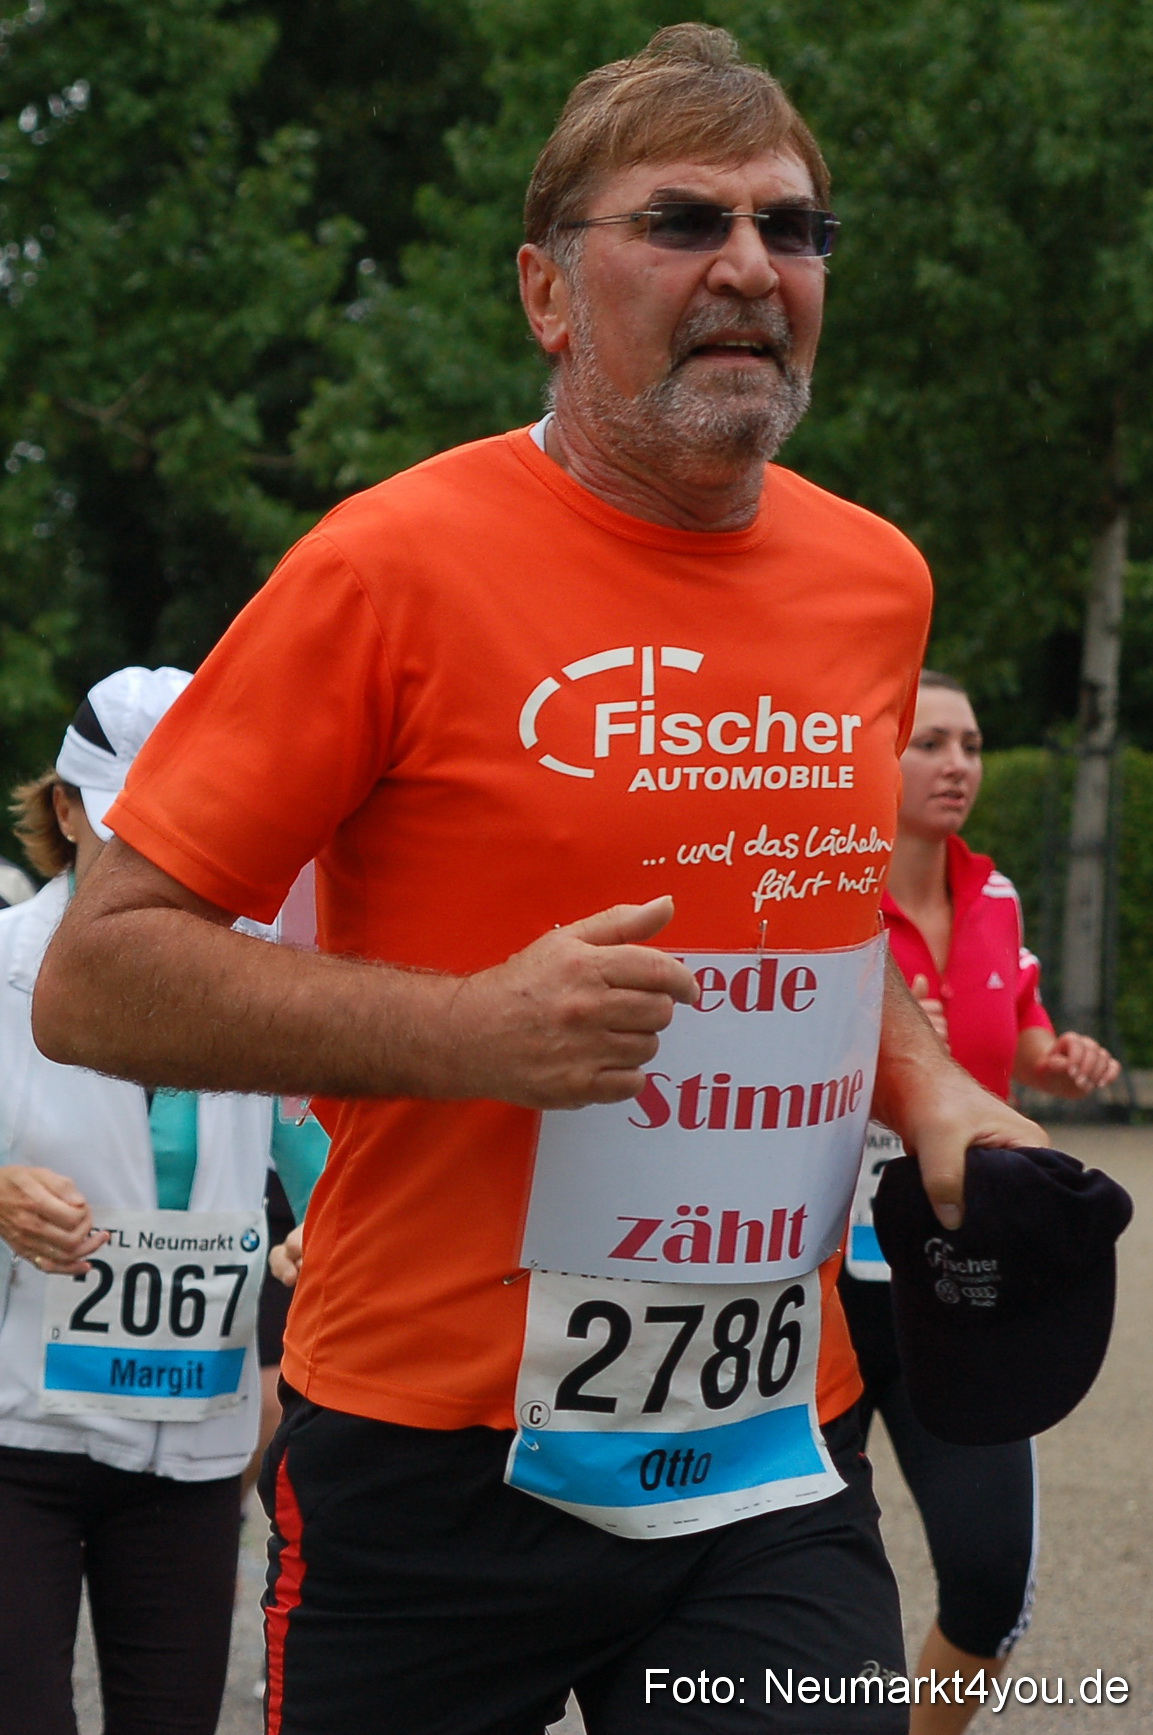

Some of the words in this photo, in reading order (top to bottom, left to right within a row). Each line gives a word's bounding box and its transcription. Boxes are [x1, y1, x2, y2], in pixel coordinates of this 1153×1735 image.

[594, 695, 862, 758] Fischer
[627, 765, 854, 792] AUTOMOBILE
[676, 830, 736, 866] und
[743, 824, 800, 859] das
[804, 823, 893, 858] Lächeln
[751, 868, 832, 913] fährt
[837, 865, 886, 895] mit!
[674, 957, 818, 1013] ede
[628, 1068, 864, 1130] Stimme
[138, 1231, 234, 1252] Neumarkt
[607, 1203, 809, 1264] zählt
[69, 1258, 249, 1339] 2067
[554, 1284, 806, 1414] 2786
[110, 1358, 205, 1396] Margit
[529, 1404, 542, 1425] C
[640, 1448, 713, 1492] Otto
